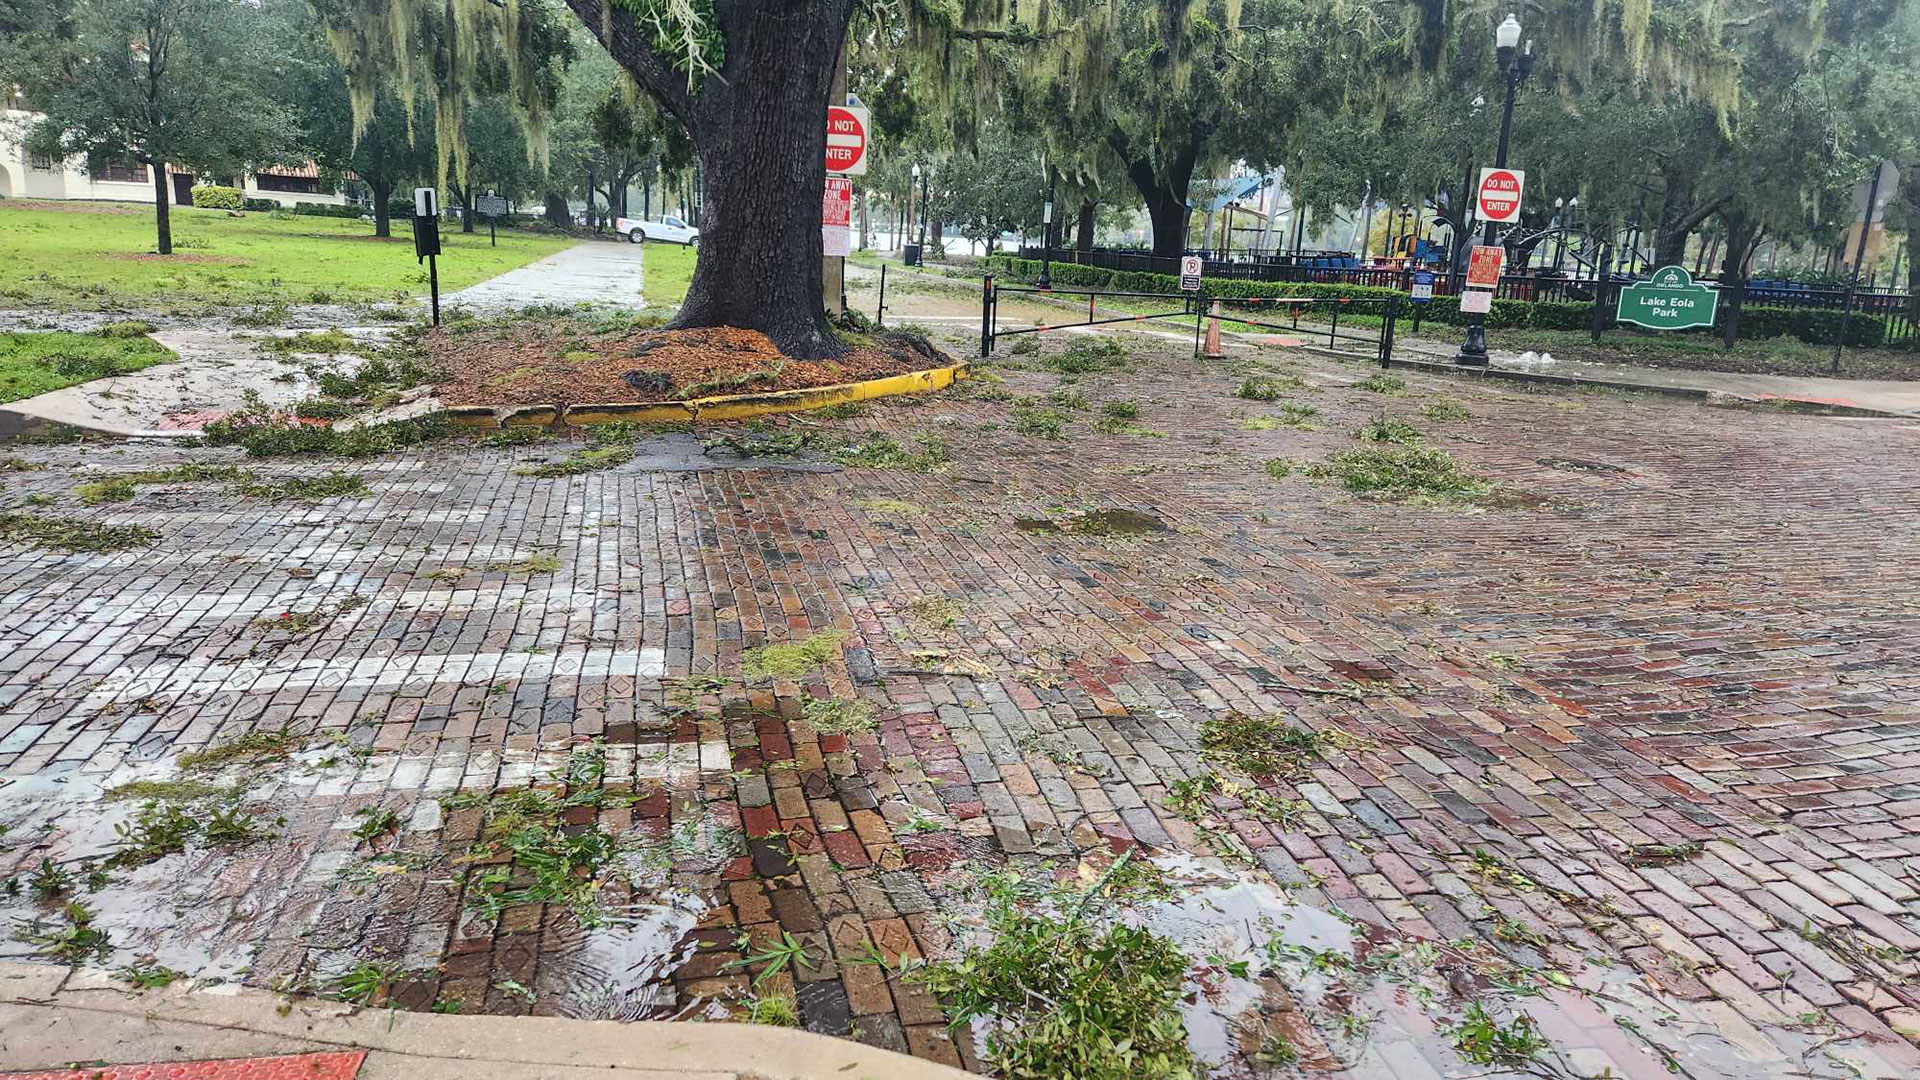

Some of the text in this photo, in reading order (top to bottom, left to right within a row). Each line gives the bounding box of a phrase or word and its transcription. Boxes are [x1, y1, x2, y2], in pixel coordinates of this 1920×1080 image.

[834, 120, 855, 132] NOT
[826, 148, 852, 160] NTER
[831, 180, 850, 191] AWAY
[1487, 178, 1516, 189] DO NOT
[824, 189, 841, 200] ZONE
[1487, 201, 1510, 211] ENTER
[1640, 296, 1694, 307] Lake Eola
[1652, 307, 1678, 317] Park
